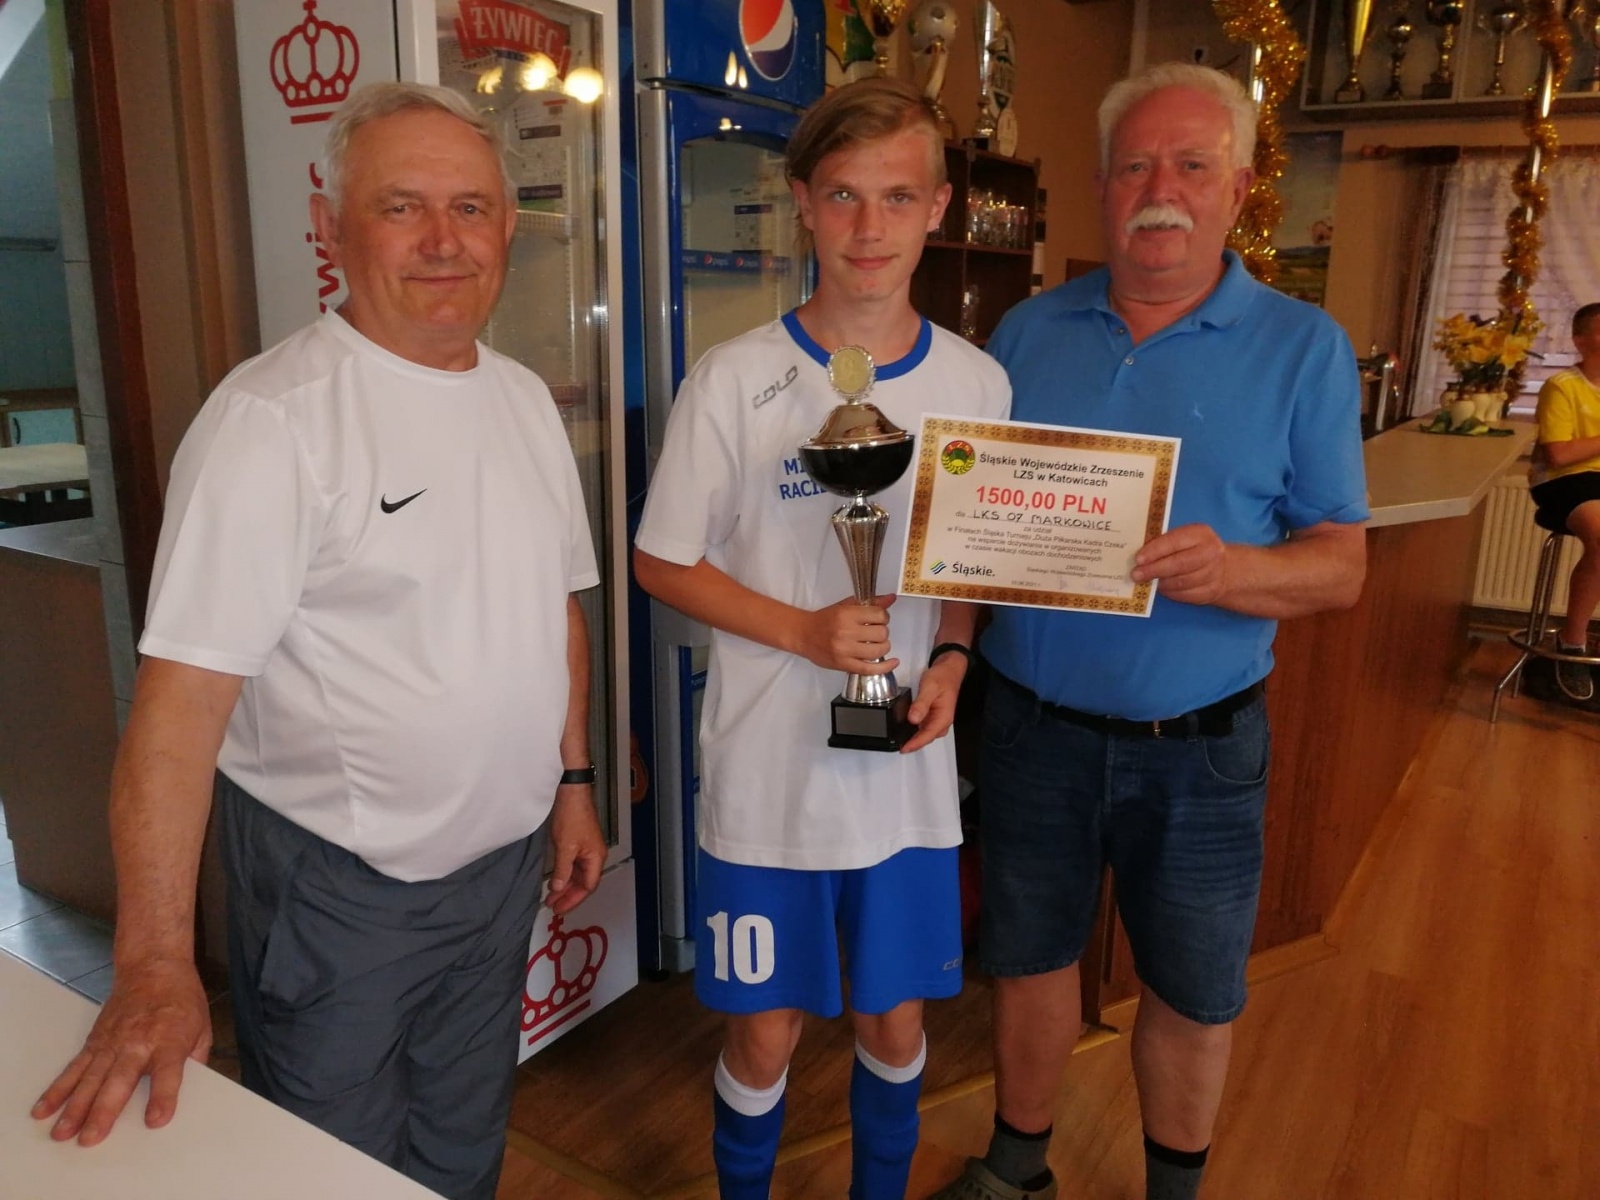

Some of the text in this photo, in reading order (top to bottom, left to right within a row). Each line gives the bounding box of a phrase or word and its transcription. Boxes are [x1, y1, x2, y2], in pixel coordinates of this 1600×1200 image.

[980, 451, 1145, 479] Śląskie Wojewódzkie Zrzeszenie
[779, 479, 827, 500] RACI
[1013, 469, 1108, 487] LZS w Katowicach
[976, 485, 1107, 515] 1500,00 PLN
[972, 509, 1000, 521] LKS
[1031, 514, 1112, 531] MARKOWICE
[706, 911, 775, 984] 10
